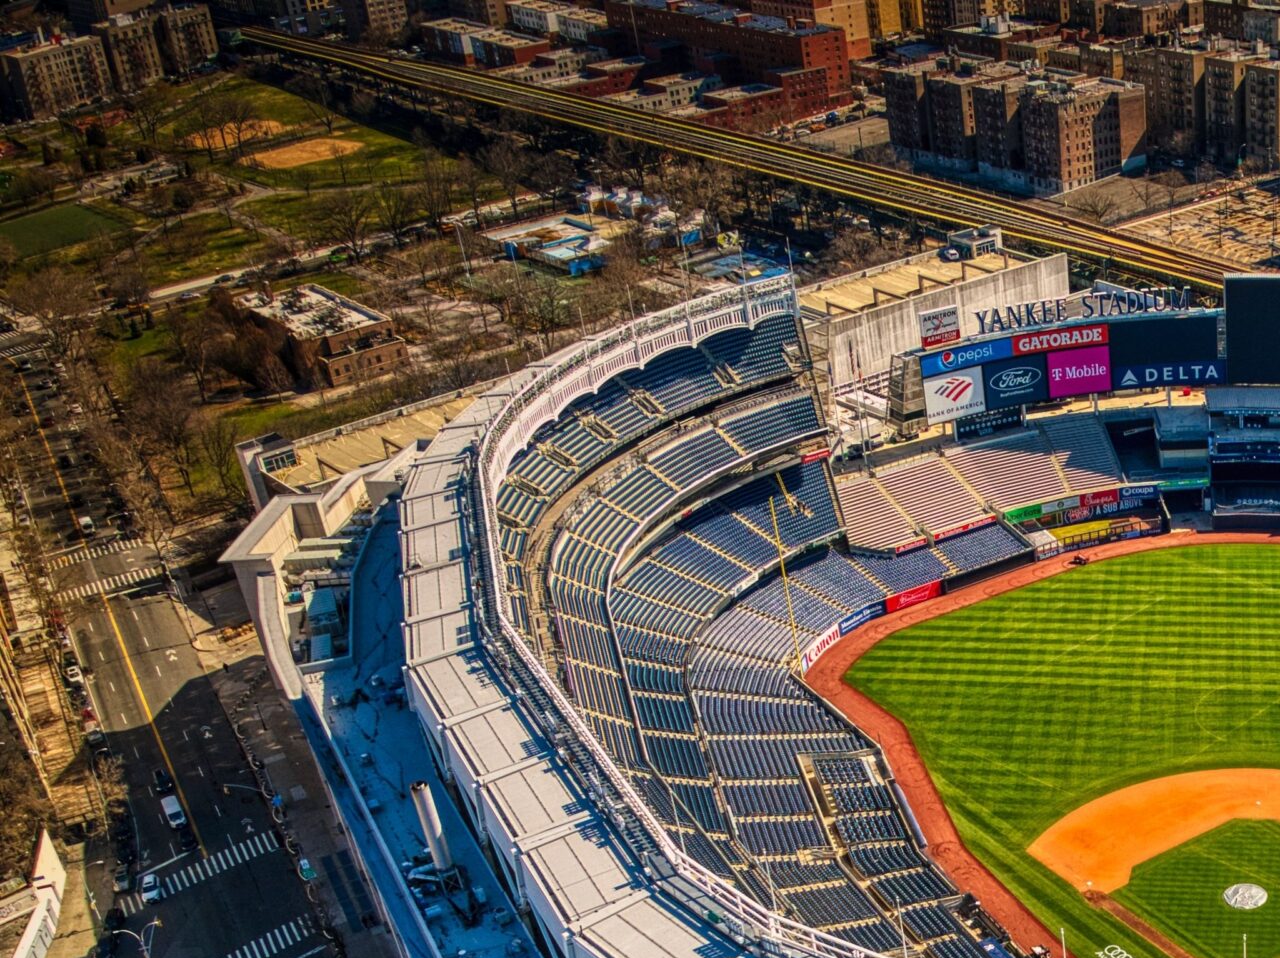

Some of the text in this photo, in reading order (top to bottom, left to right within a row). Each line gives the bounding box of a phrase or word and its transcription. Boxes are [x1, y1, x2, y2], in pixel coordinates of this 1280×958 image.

[923, 310, 957, 322] ARMITRON
[973, 286, 1191, 334] YANKEE STADIUM
[926, 330, 957, 343] ARMITRON
[1018, 328, 1103, 352] GATORADE
[957, 344, 993, 364] pepsi
[999, 370, 1032, 388] Ford
[1065, 363, 1107, 379] Mobile
[1145, 364, 1219, 382] DELTA
[928, 401, 984, 419] BANK OF AMERICA
[1131, 487, 1154, 498] coupa
[1102, 502, 1119, 513] SUB
[1119, 498, 1143, 510] ABOVE
[806, 628, 839, 664] Canon
